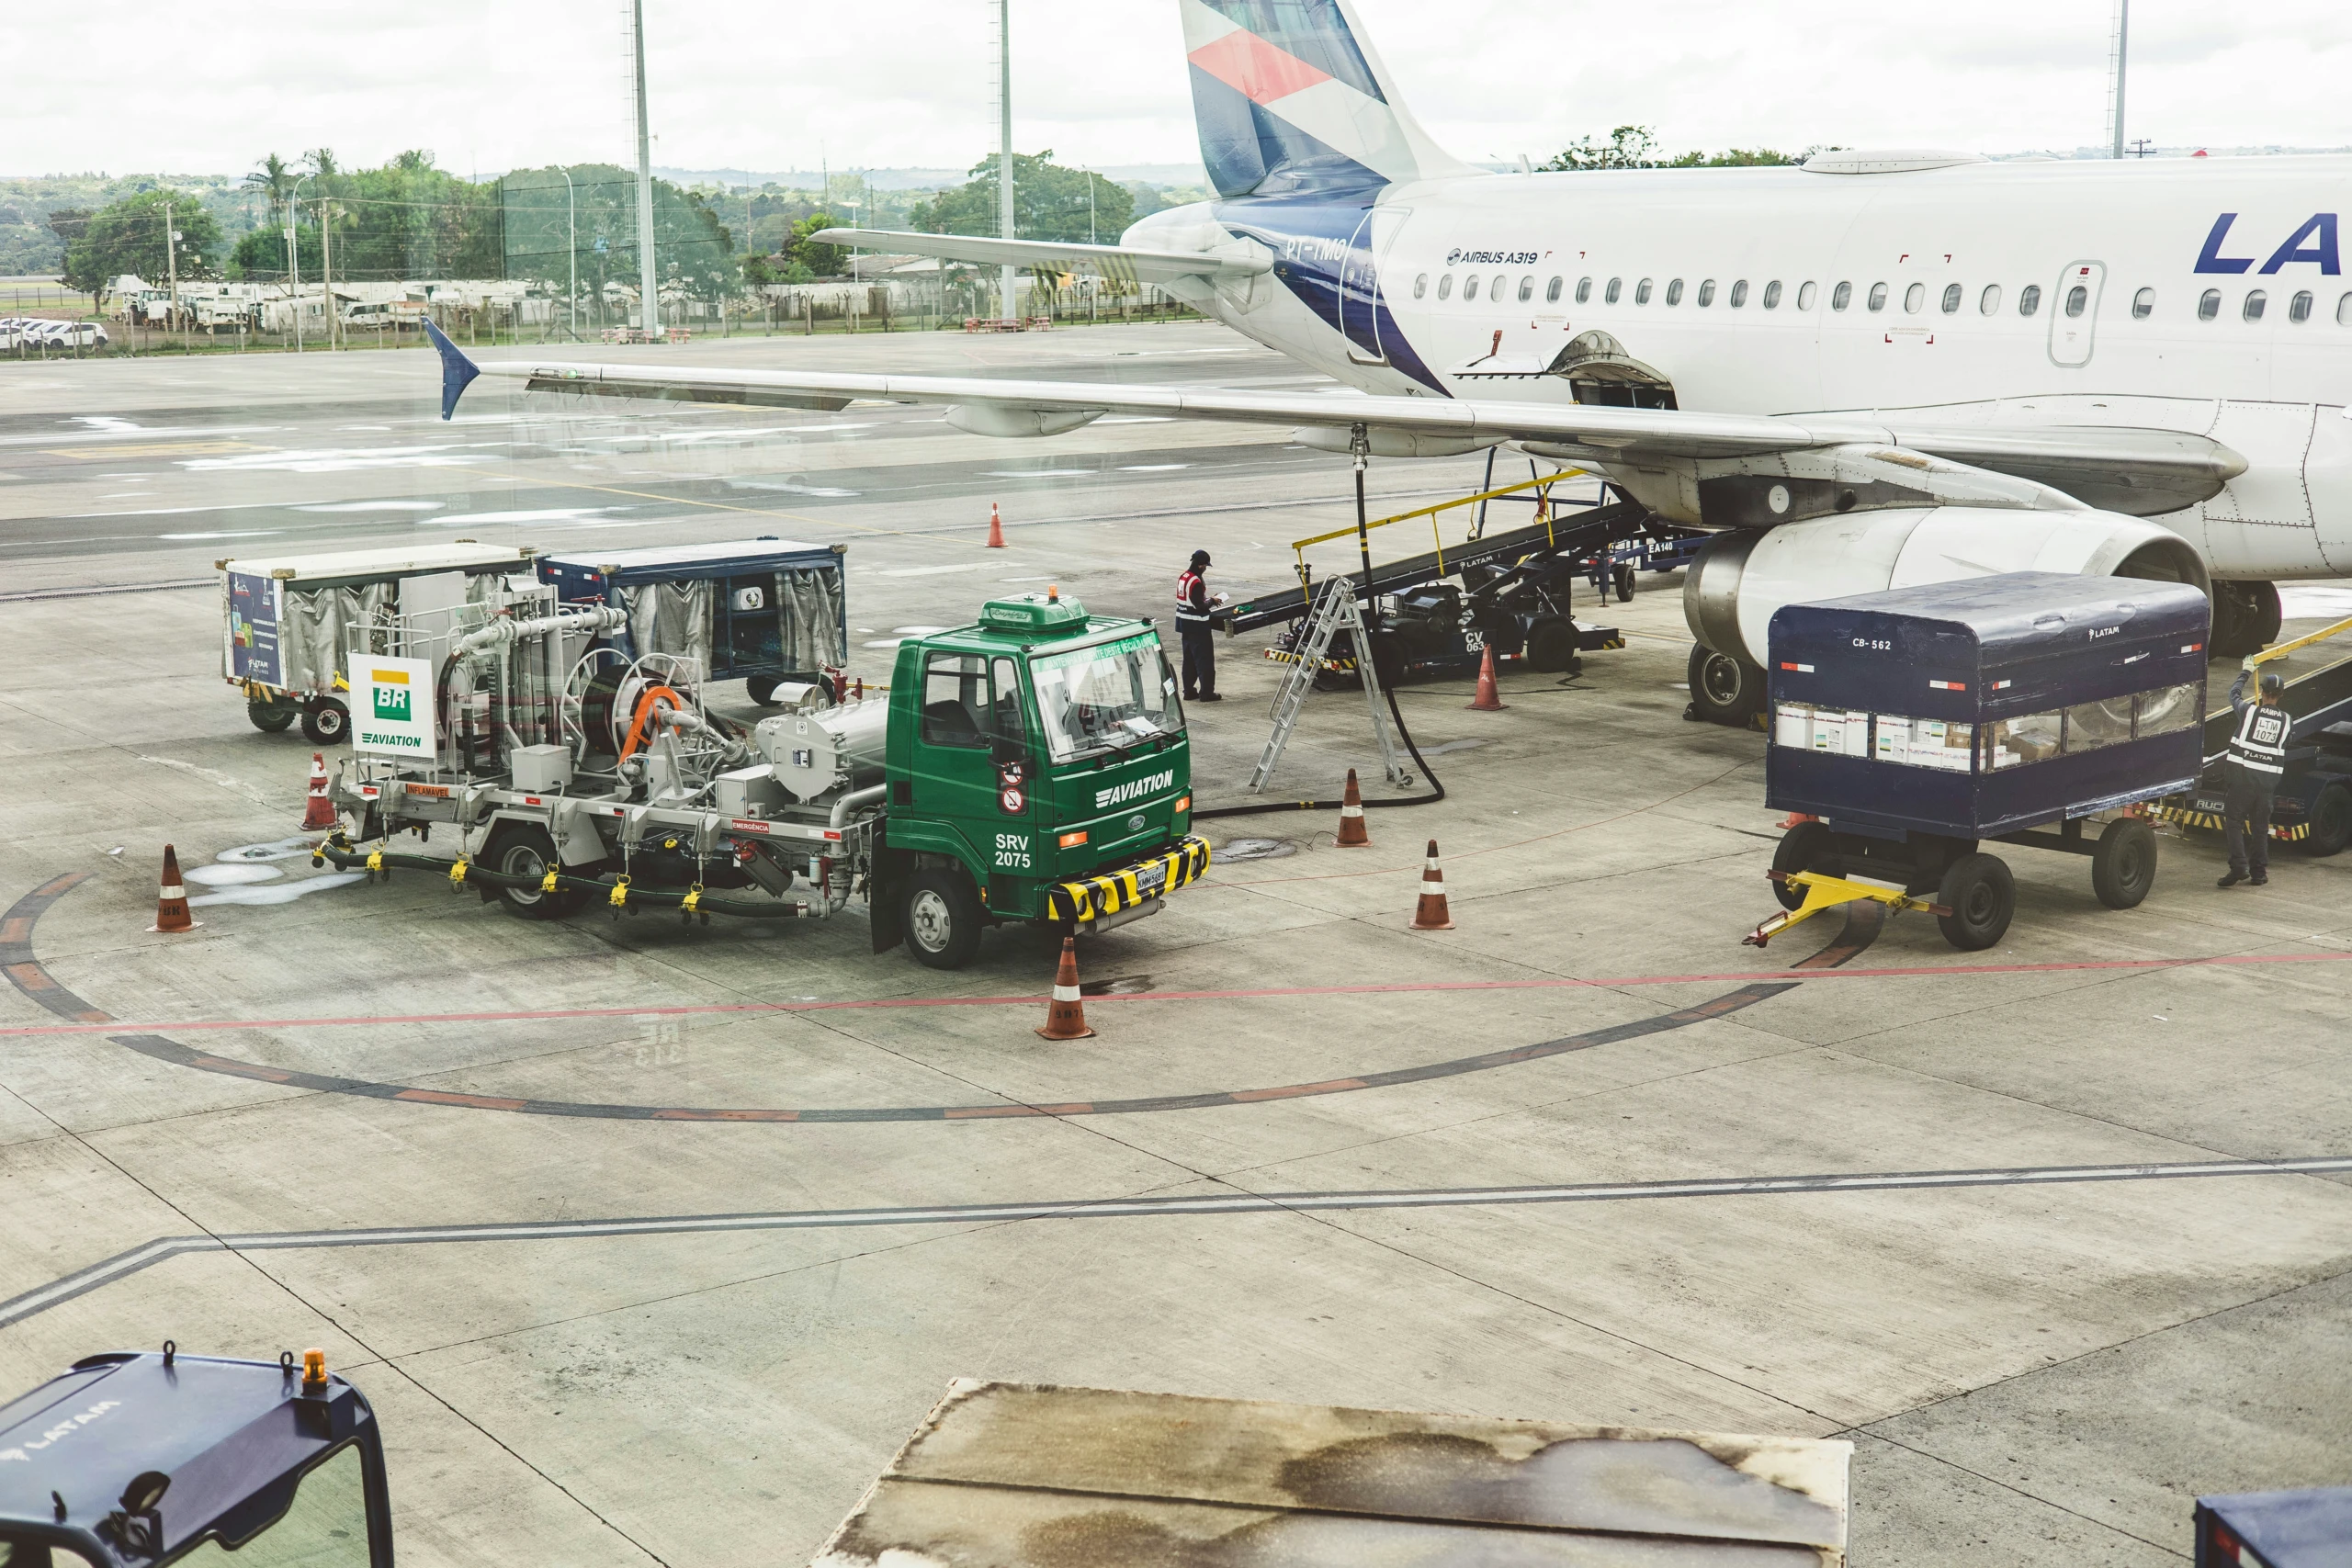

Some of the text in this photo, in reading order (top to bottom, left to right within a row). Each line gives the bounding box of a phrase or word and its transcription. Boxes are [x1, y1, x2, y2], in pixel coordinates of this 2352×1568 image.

[2193, 213, 2341, 276] LA
[1461, 252, 1538, 264] AIRBUS A319
[1649, 542, 1673, 553] EA140
[1466, 555, 1493, 568] LATAM
[1465, 631, 1483, 643] CV
[2095, 626, 2120, 637] LATAM
[1466, 641, 1485, 652] 063
[1871, 639, 1891, 649] 562
[1104, 647, 1121, 658] DESTE
[378, 689, 406, 708] BR
[2260, 707, 2282, 717] RAMPA
[2258, 719, 2278, 731] LTM
[371, 734, 421, 747] AVIATION
[2256, 729, 2277, 741] 1073
[2249, 752, 2273, 761] LATAM
[408, 784, 449, 797] INFLAMÁVEL
[1109, 769, 1173, 805] AVIATION
[732, 822, 769, 831] EMERGÊNCIA
[995, 834, 1028, 851] SRV
[995, 852, 1031, 868] 2075
[24, 1401, 121, 1446] LATAM
